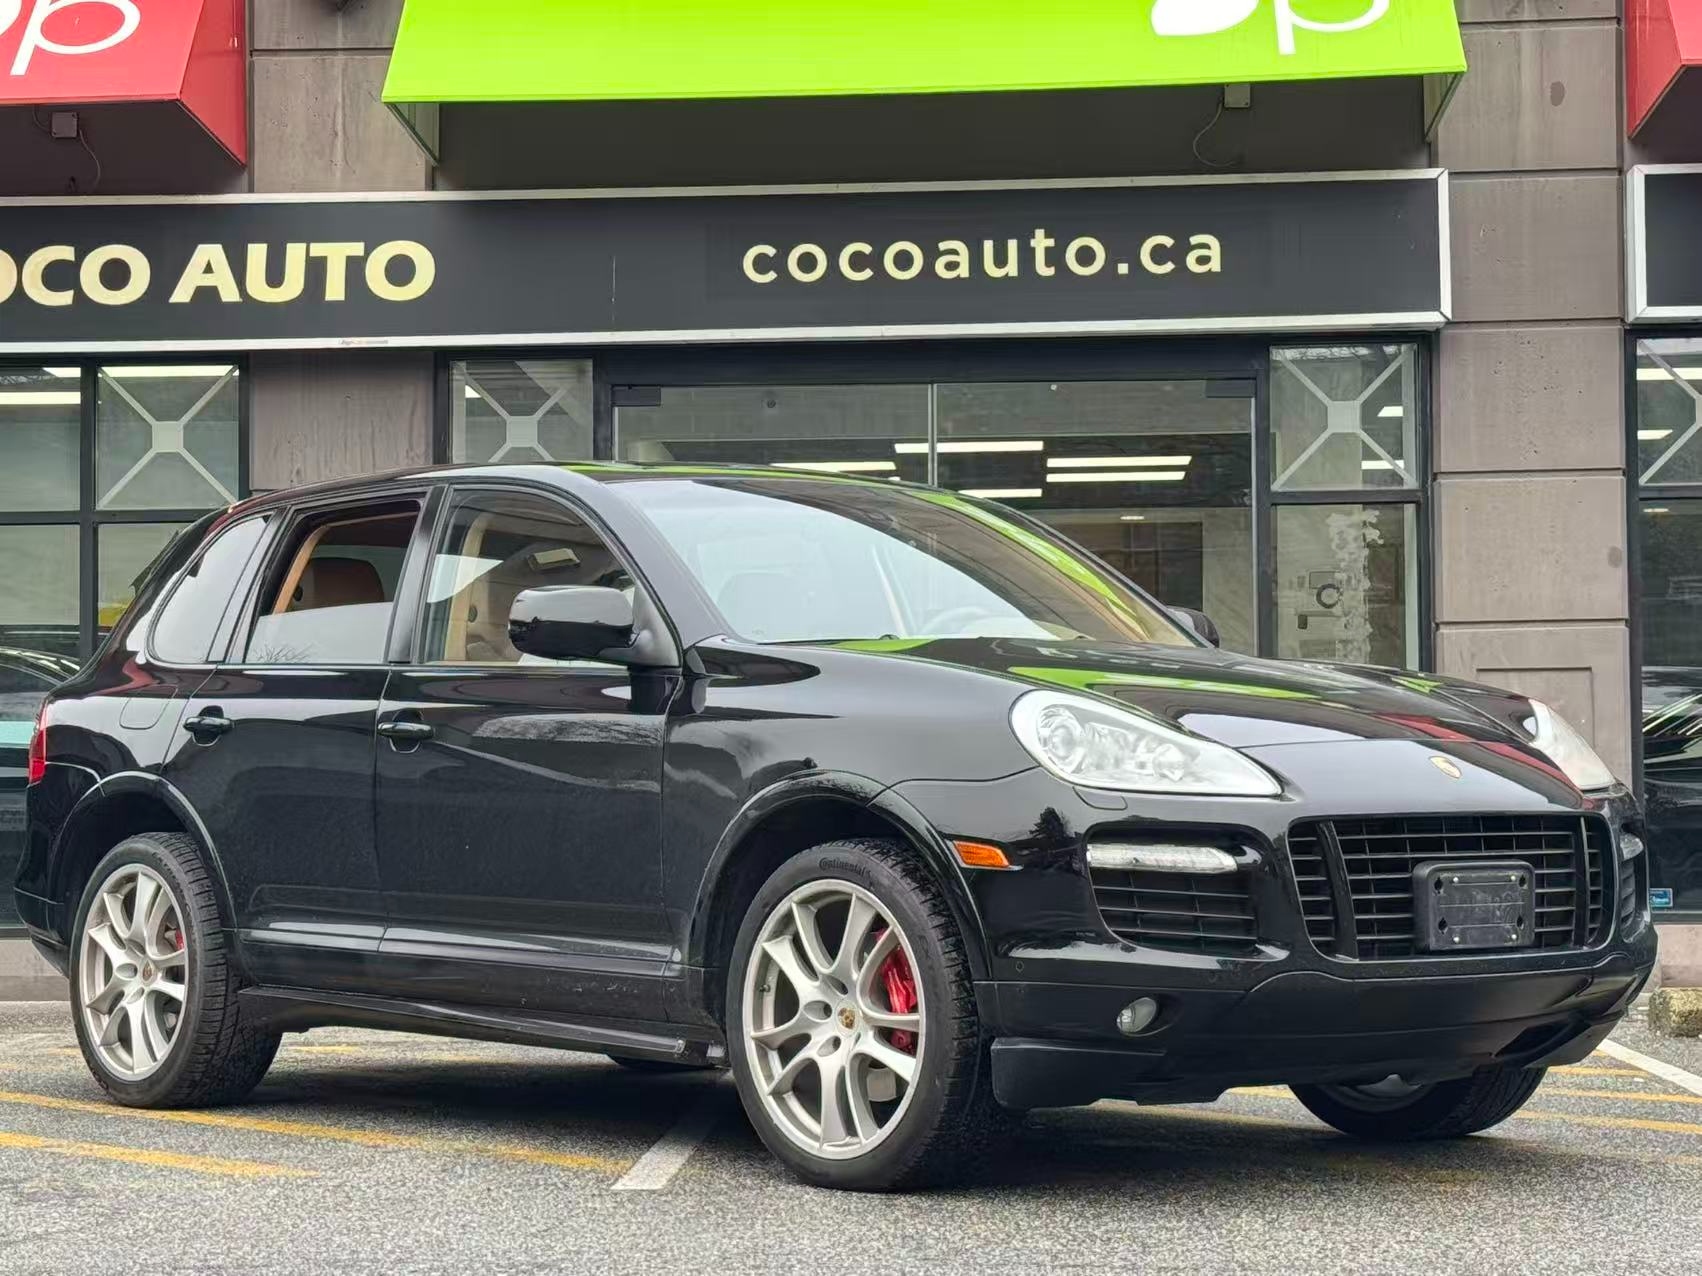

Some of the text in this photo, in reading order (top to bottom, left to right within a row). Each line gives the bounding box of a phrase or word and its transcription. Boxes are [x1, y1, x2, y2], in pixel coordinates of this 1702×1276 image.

[0, 240, 436, 306] CO AUTO
[742, 228, 1222, 283] cocoauto.ca
